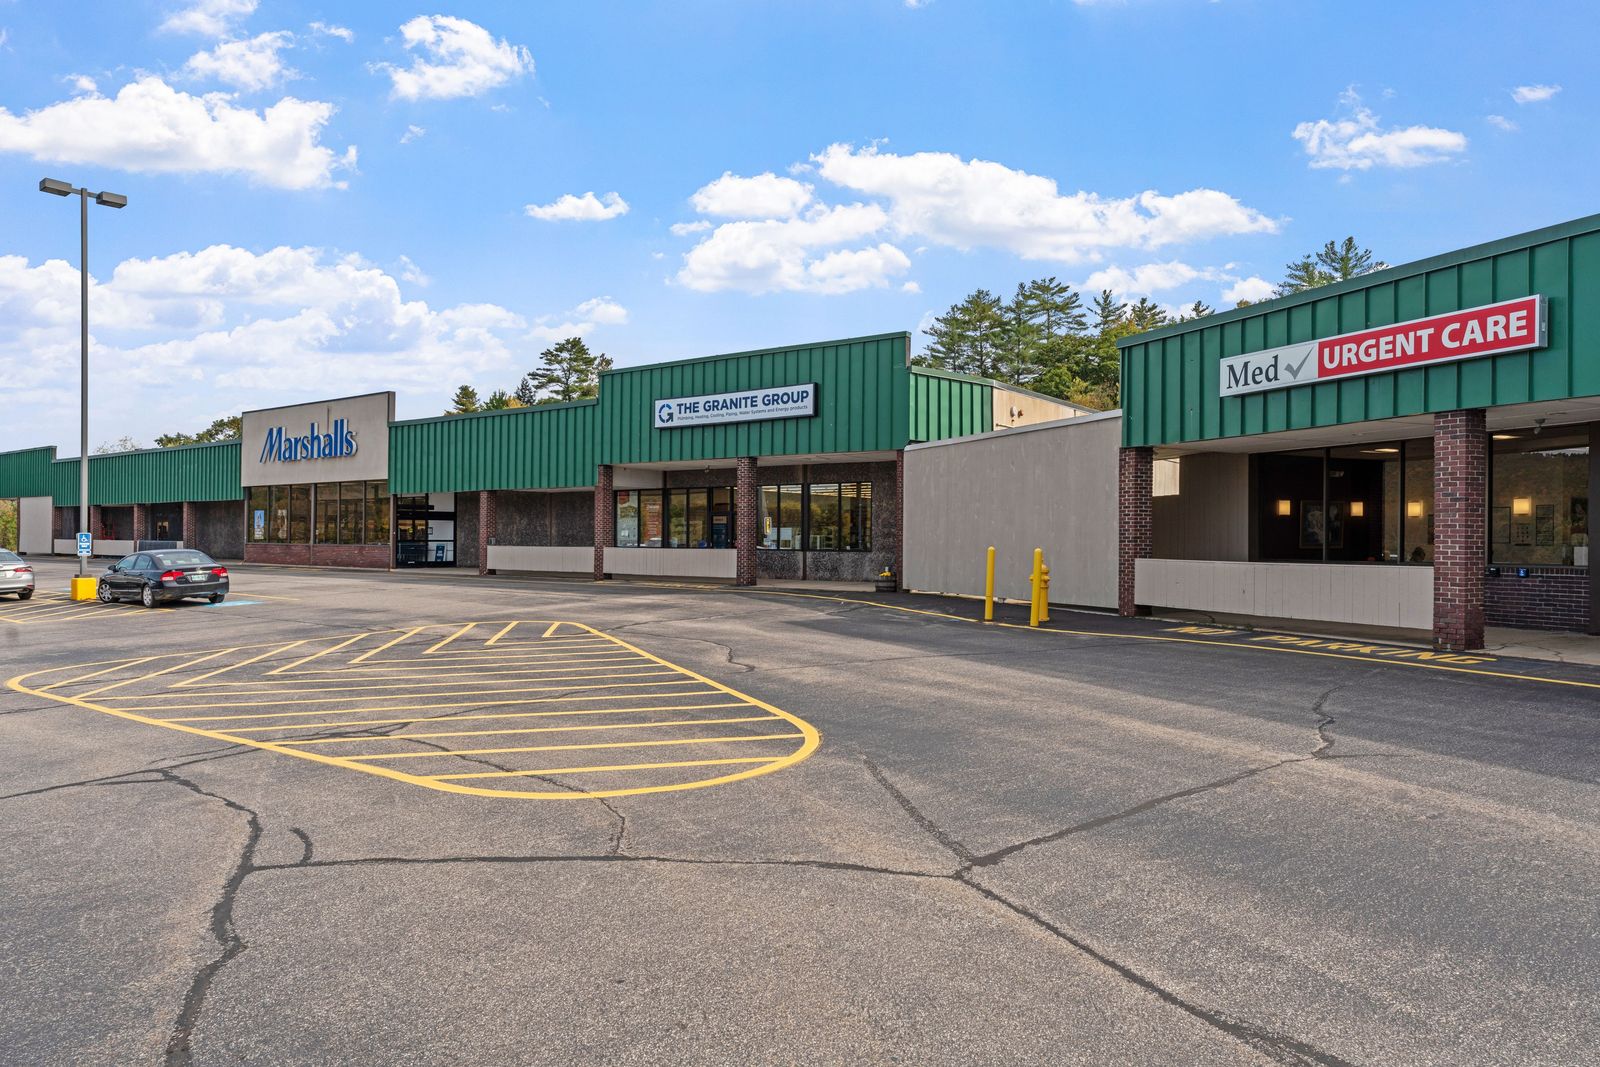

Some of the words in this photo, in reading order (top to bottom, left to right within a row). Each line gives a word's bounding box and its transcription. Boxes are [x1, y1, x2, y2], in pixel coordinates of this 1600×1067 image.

[1226, 354, 1279, 389] Med
[1323, 328, 1434, 369] URGENT
[1442, 310, 1528, 348] CARE
[676, 401, 700, 415] THE
[703, 395, 758, 411] GRANITE
[762, 390, 809, 407] GROUP
[260, 418, 358, 464] Marshalls
[1249, 635, 1497, 665] PARKING
